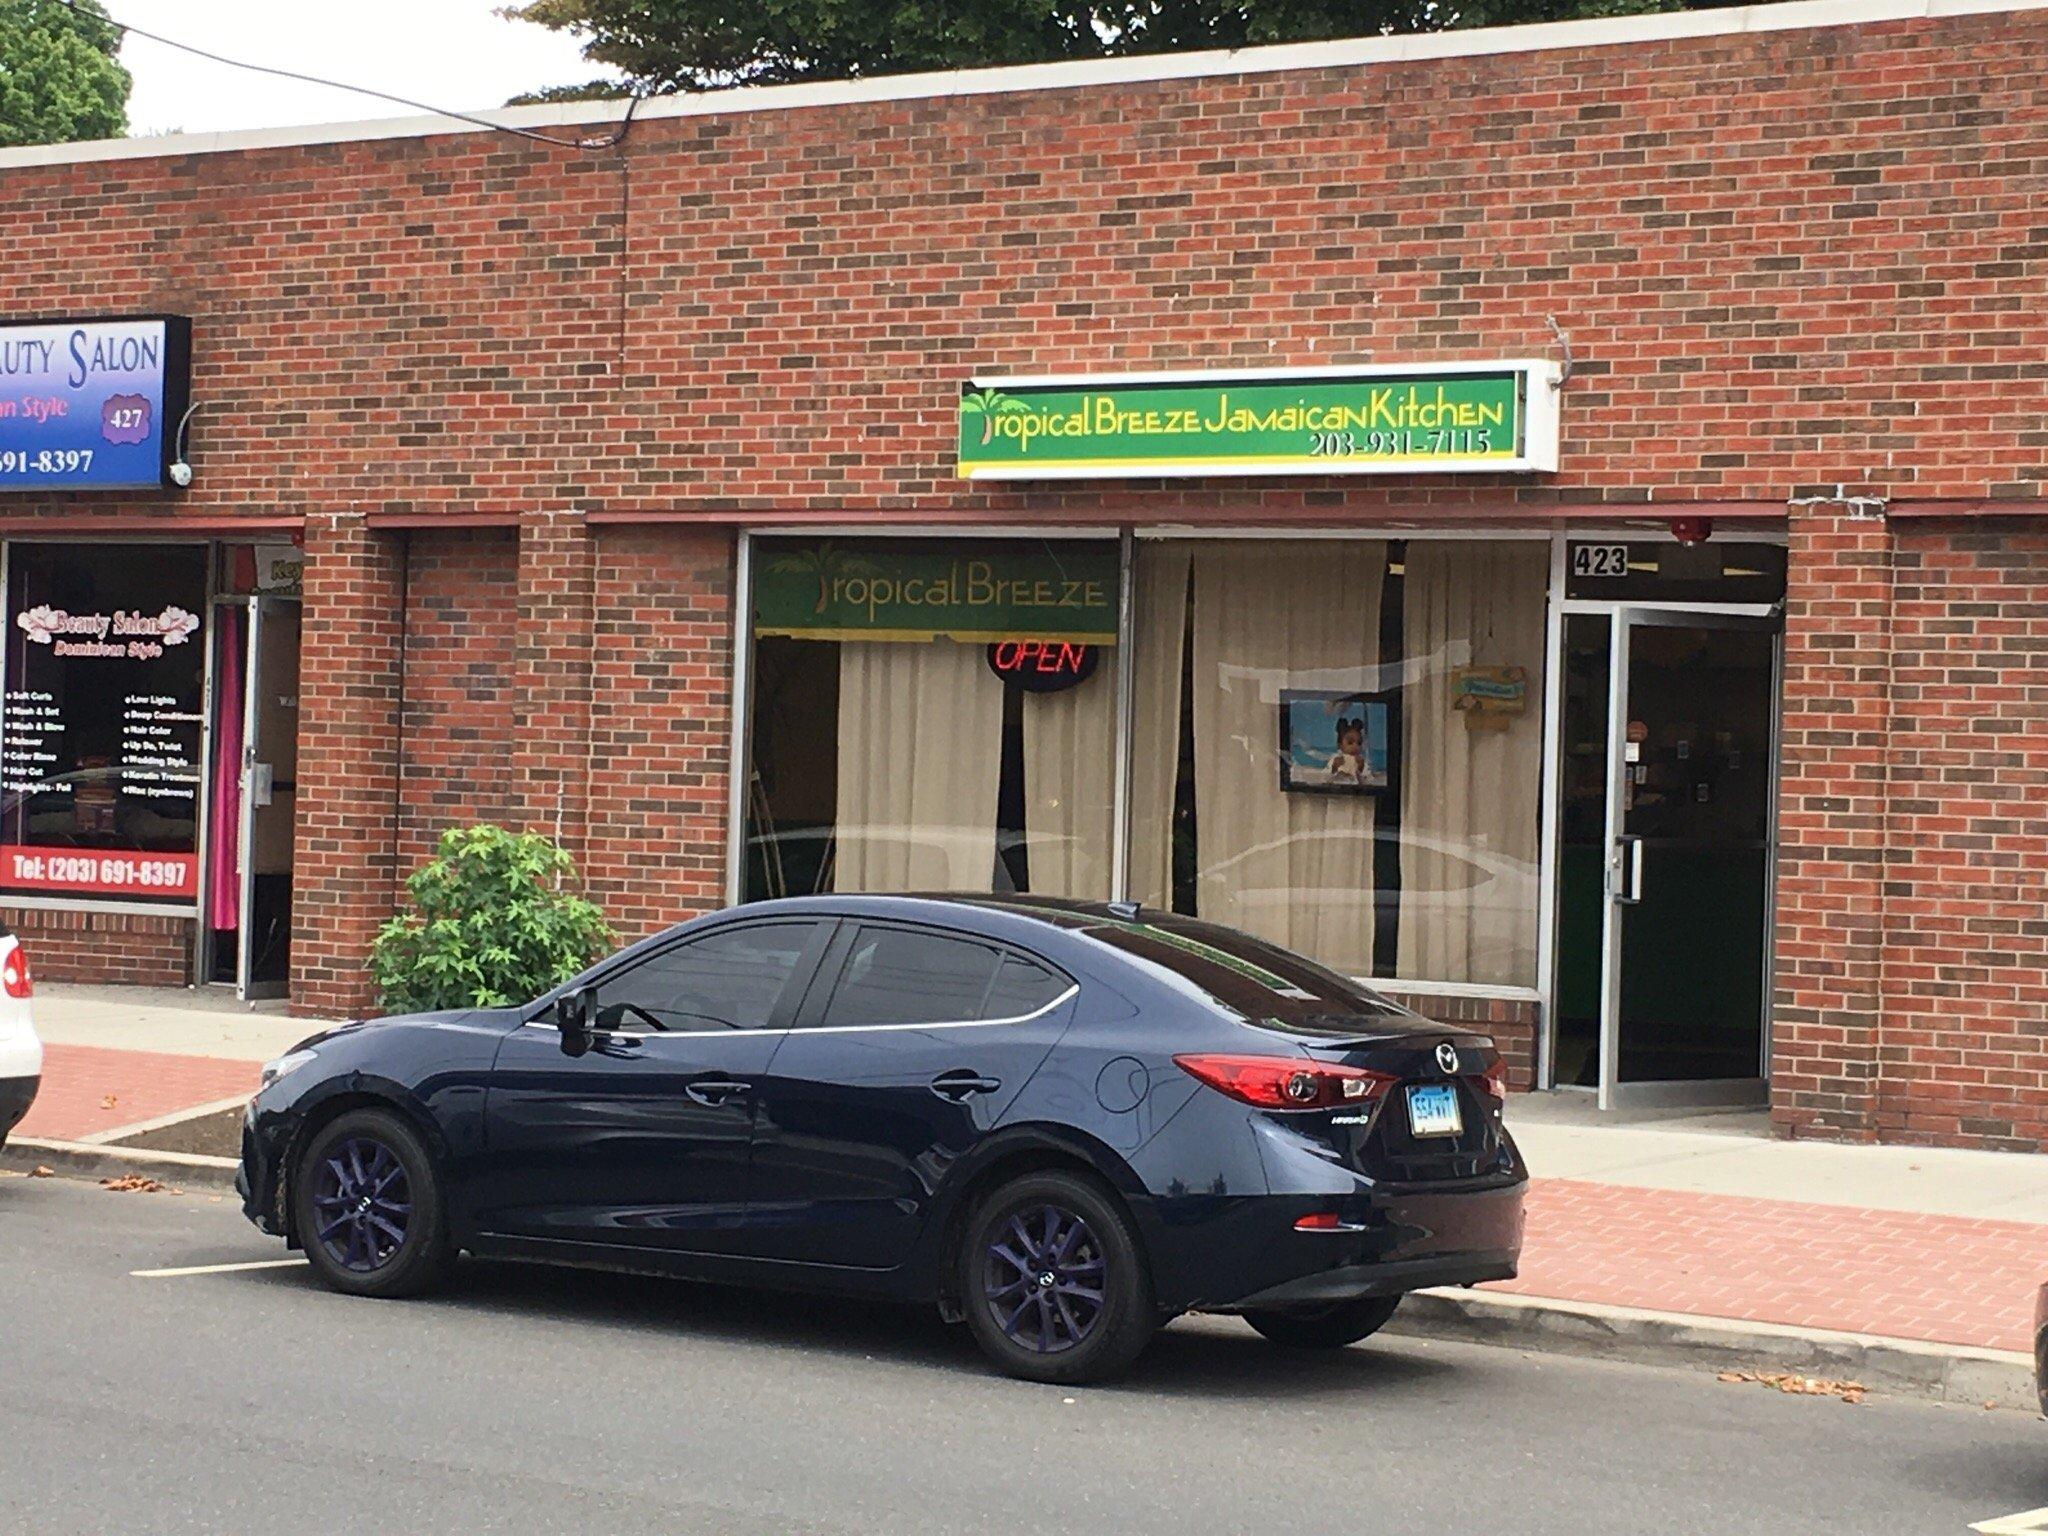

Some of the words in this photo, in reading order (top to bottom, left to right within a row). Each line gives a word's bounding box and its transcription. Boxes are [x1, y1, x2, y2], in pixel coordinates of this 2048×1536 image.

[0, 340, 55, 374] UTY
[22, 396, 68, 423] Style
[110, 409, 143, 428] 427
[962, 388, 1092, 452] Tropical
[1308, 429, 1492, 458] 203-931-7115
[1575, 547, 1626, 575] 423
[55, 610, 111, 640] Beauty
[112, 610, 160, 635] Salon
[995, 639, 1087, 674] OPEN
[13, 855, 45, 880] Tel:
[48, 856, 98, 883] (203)
[101, 859, 187, 887] 691-8397
